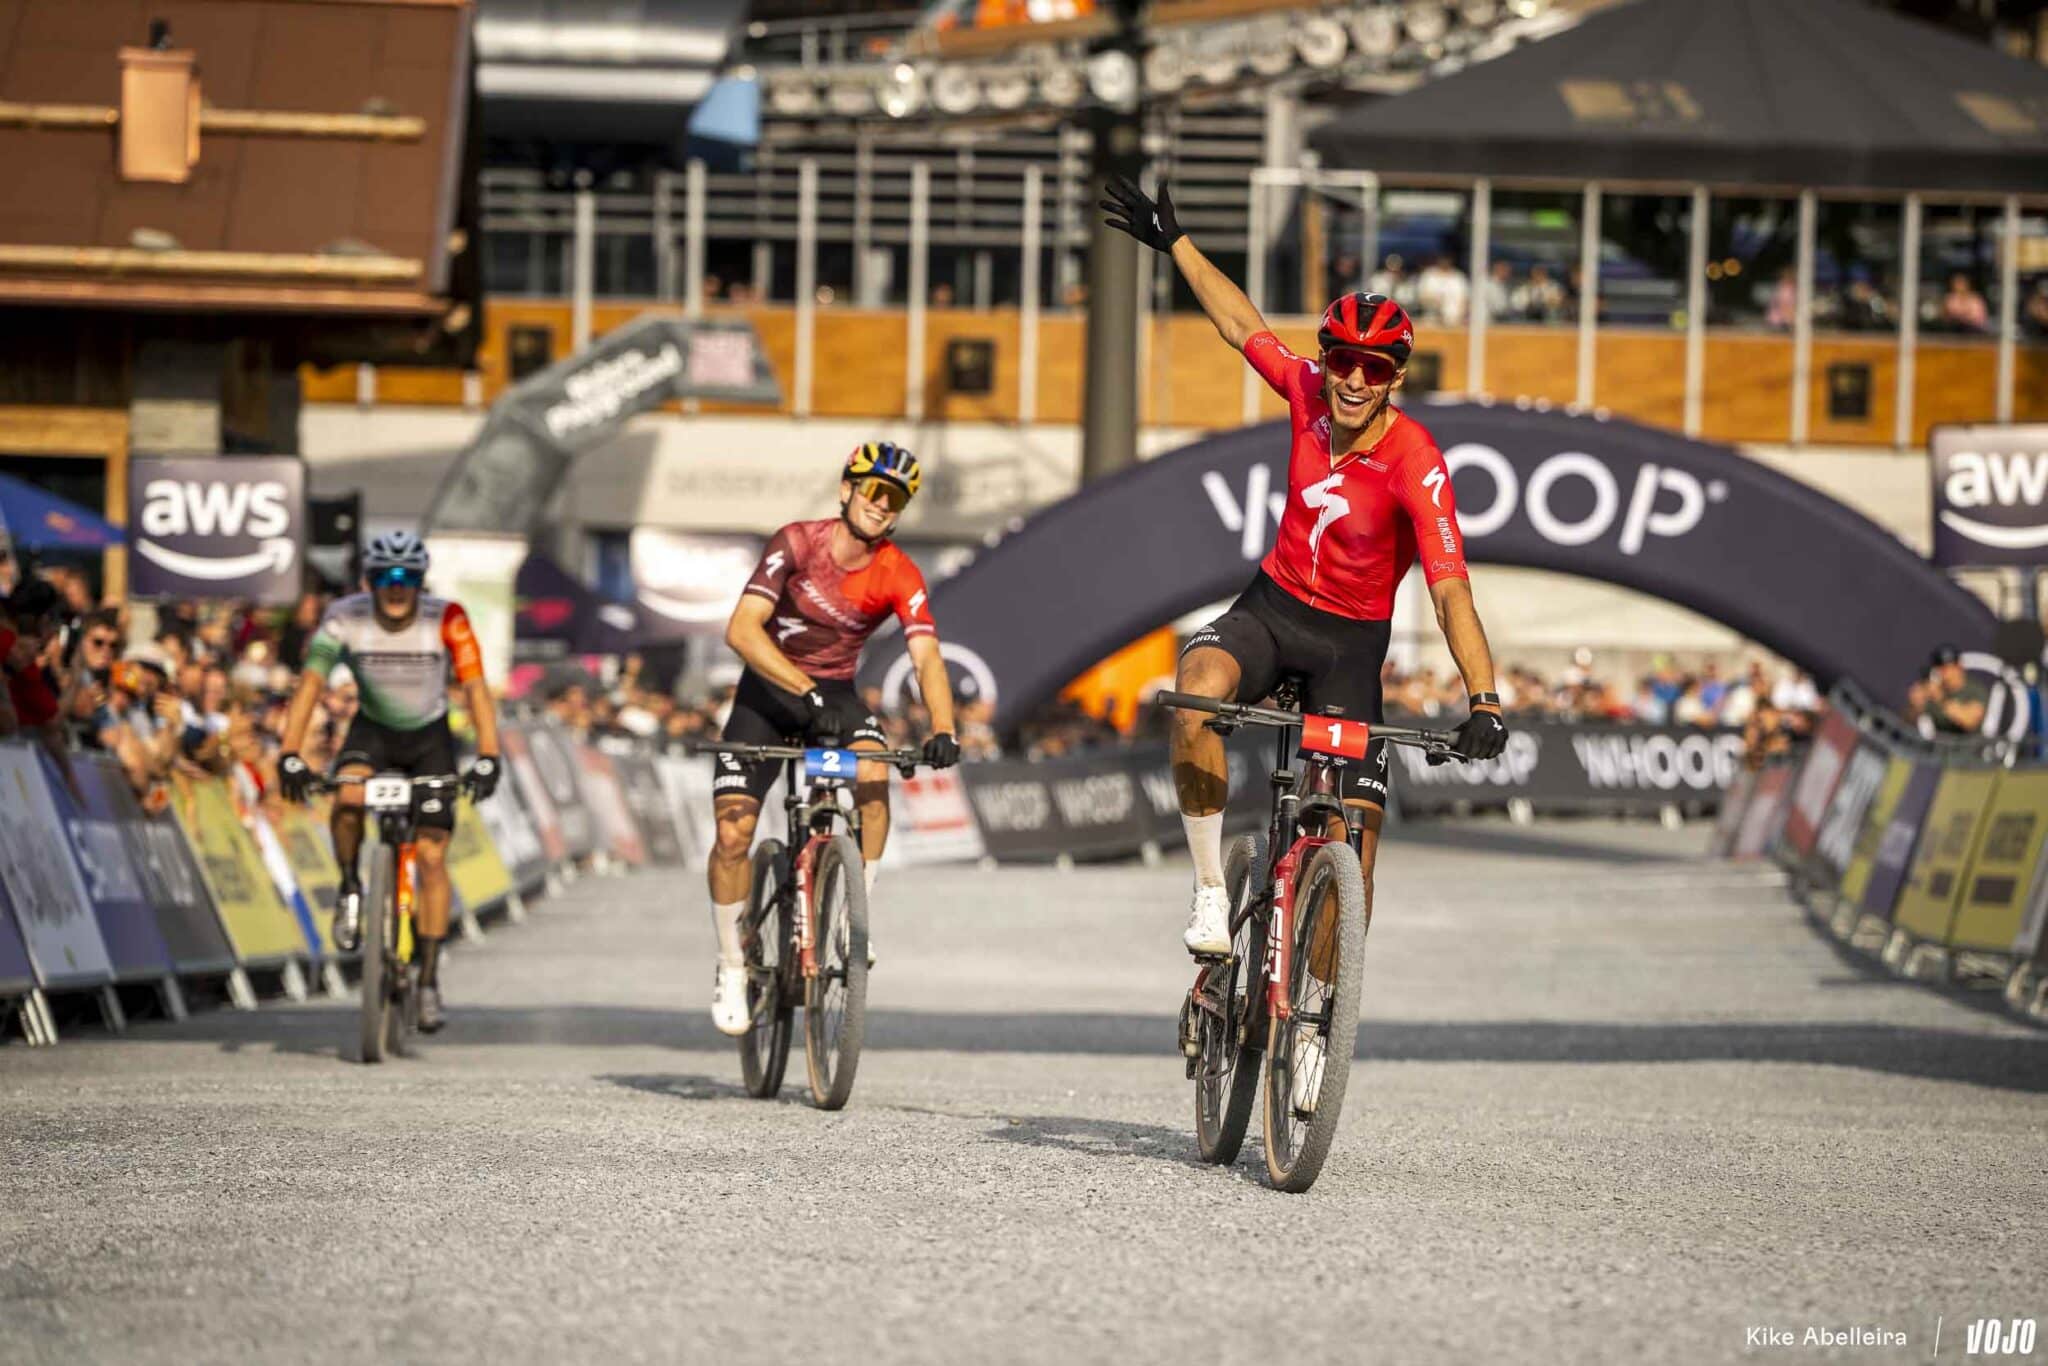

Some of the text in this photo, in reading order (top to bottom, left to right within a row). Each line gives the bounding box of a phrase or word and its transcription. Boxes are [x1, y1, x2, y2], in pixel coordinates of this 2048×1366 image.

[1202, 443, 1706, 560] WOOP
[1945, 451, 2048, 507] aw
[141, 479, 290, 538] aws
[822, 751, 841, 772] 2
[1327, 723, 1343, 748] 1
